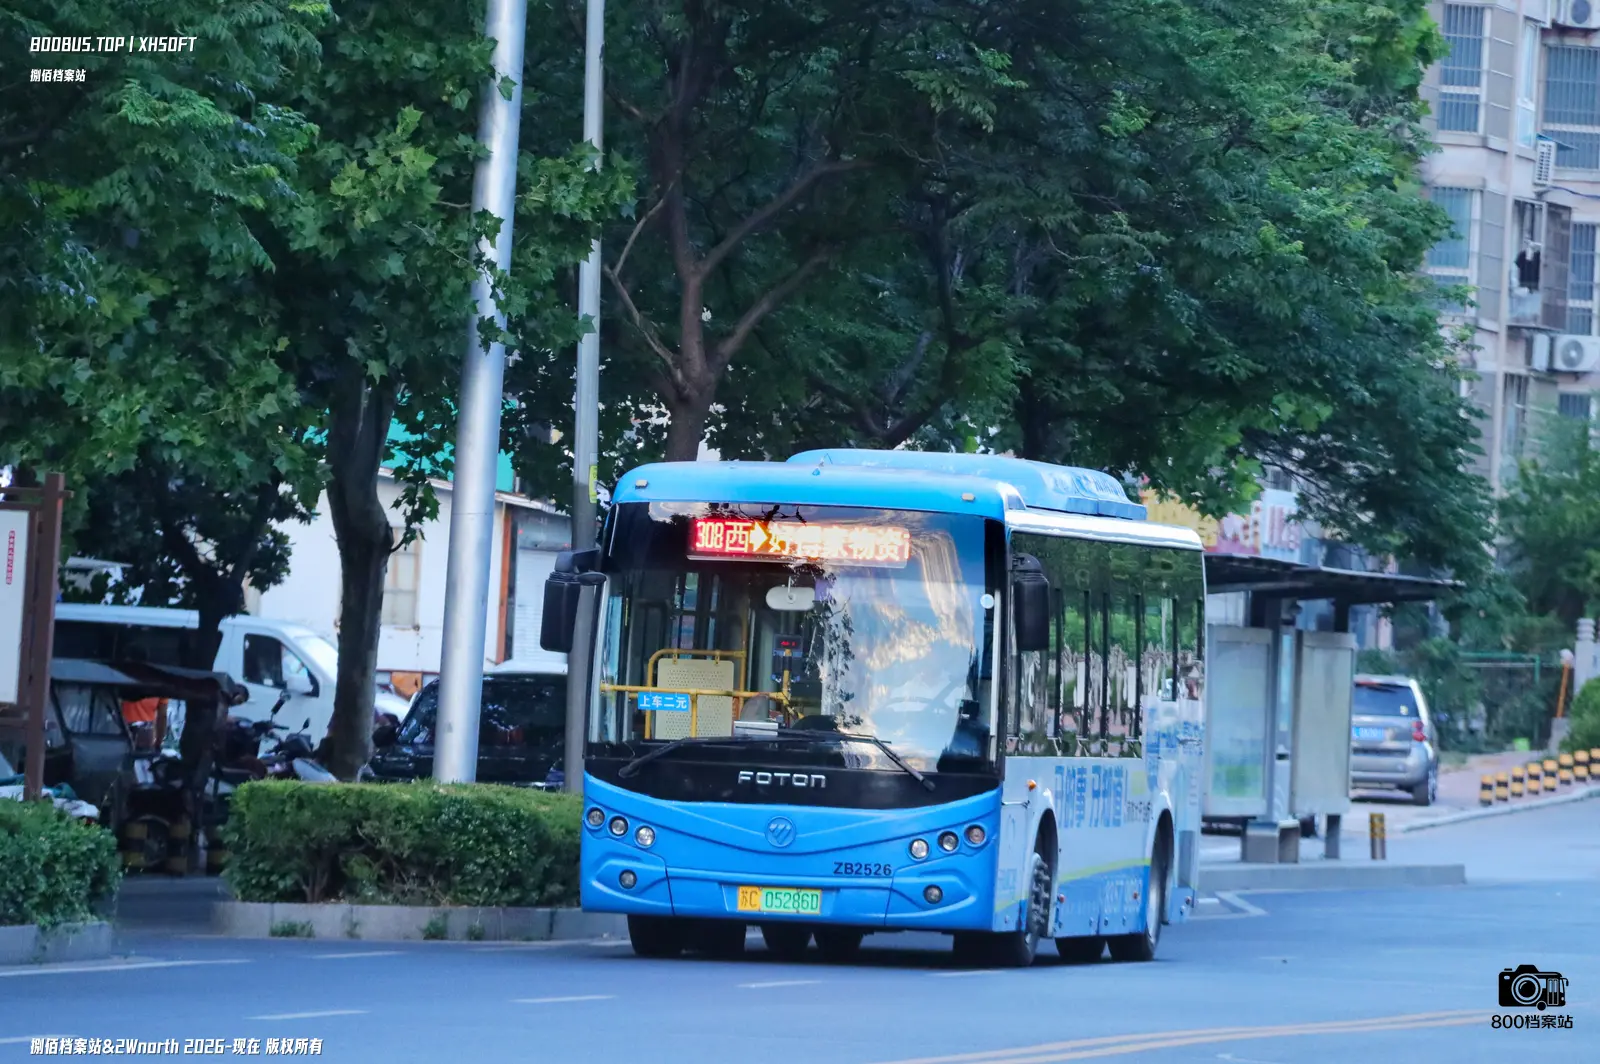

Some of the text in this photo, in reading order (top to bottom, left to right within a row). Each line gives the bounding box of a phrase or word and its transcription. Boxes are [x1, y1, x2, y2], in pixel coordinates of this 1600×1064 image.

[639, 694, 687, 709] 上车二元
[738, 770, 826, 788] FOTON
[833, 861, 892, 876] ZB2526
[765, 890, 819, 910] 05286D
